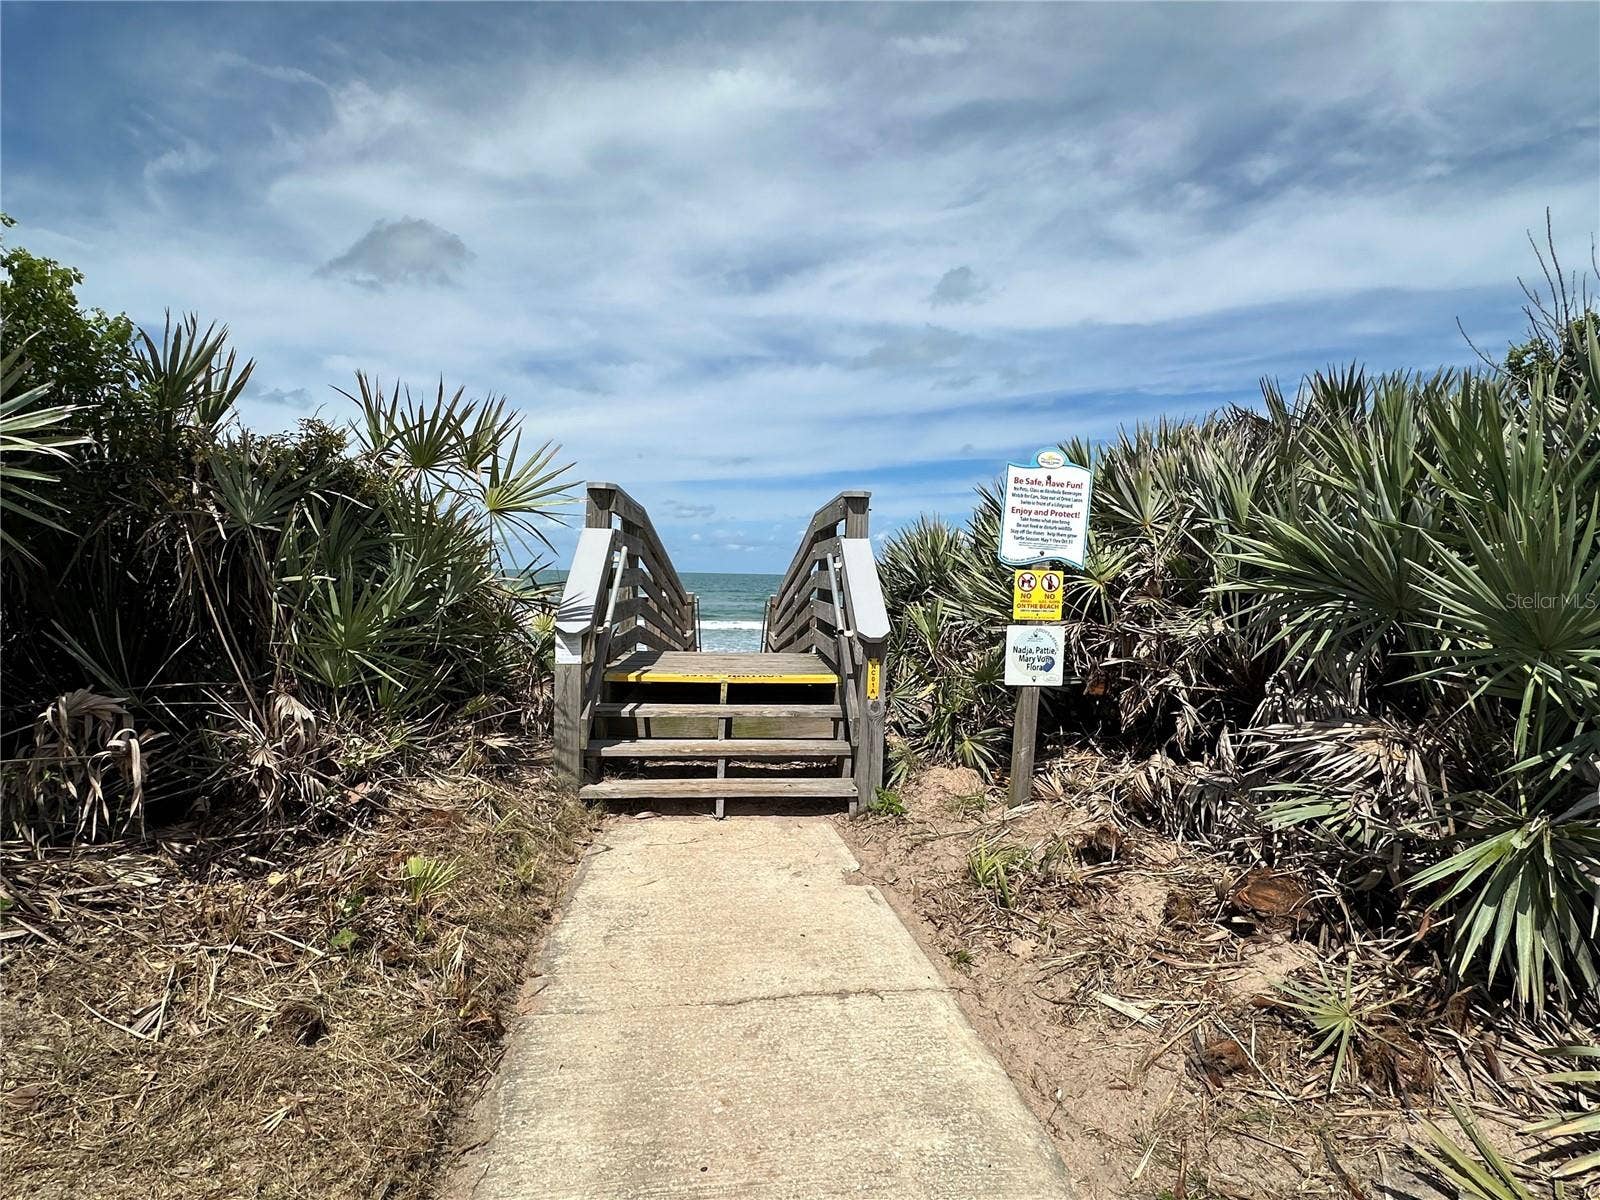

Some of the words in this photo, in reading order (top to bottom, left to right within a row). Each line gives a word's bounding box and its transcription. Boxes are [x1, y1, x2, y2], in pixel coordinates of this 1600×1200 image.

[1014, 476, 1024, 484] Be
[1025, 478, 1044, 486] Safe,
[1046, 479, 1064, 488] Have
[1066, 481, 1083, 489] Fun!
[1011, 506, 1032, 516] Enjoy
[1050, 509, 1080, 518] Protect!
[1012, 646, 1034, 655] Nadja,
[1036, 646, 1056, 655] Pattie,
[1018, 654, 1036, 664] Mary
[1026, 662, 1043, 671] Flora
